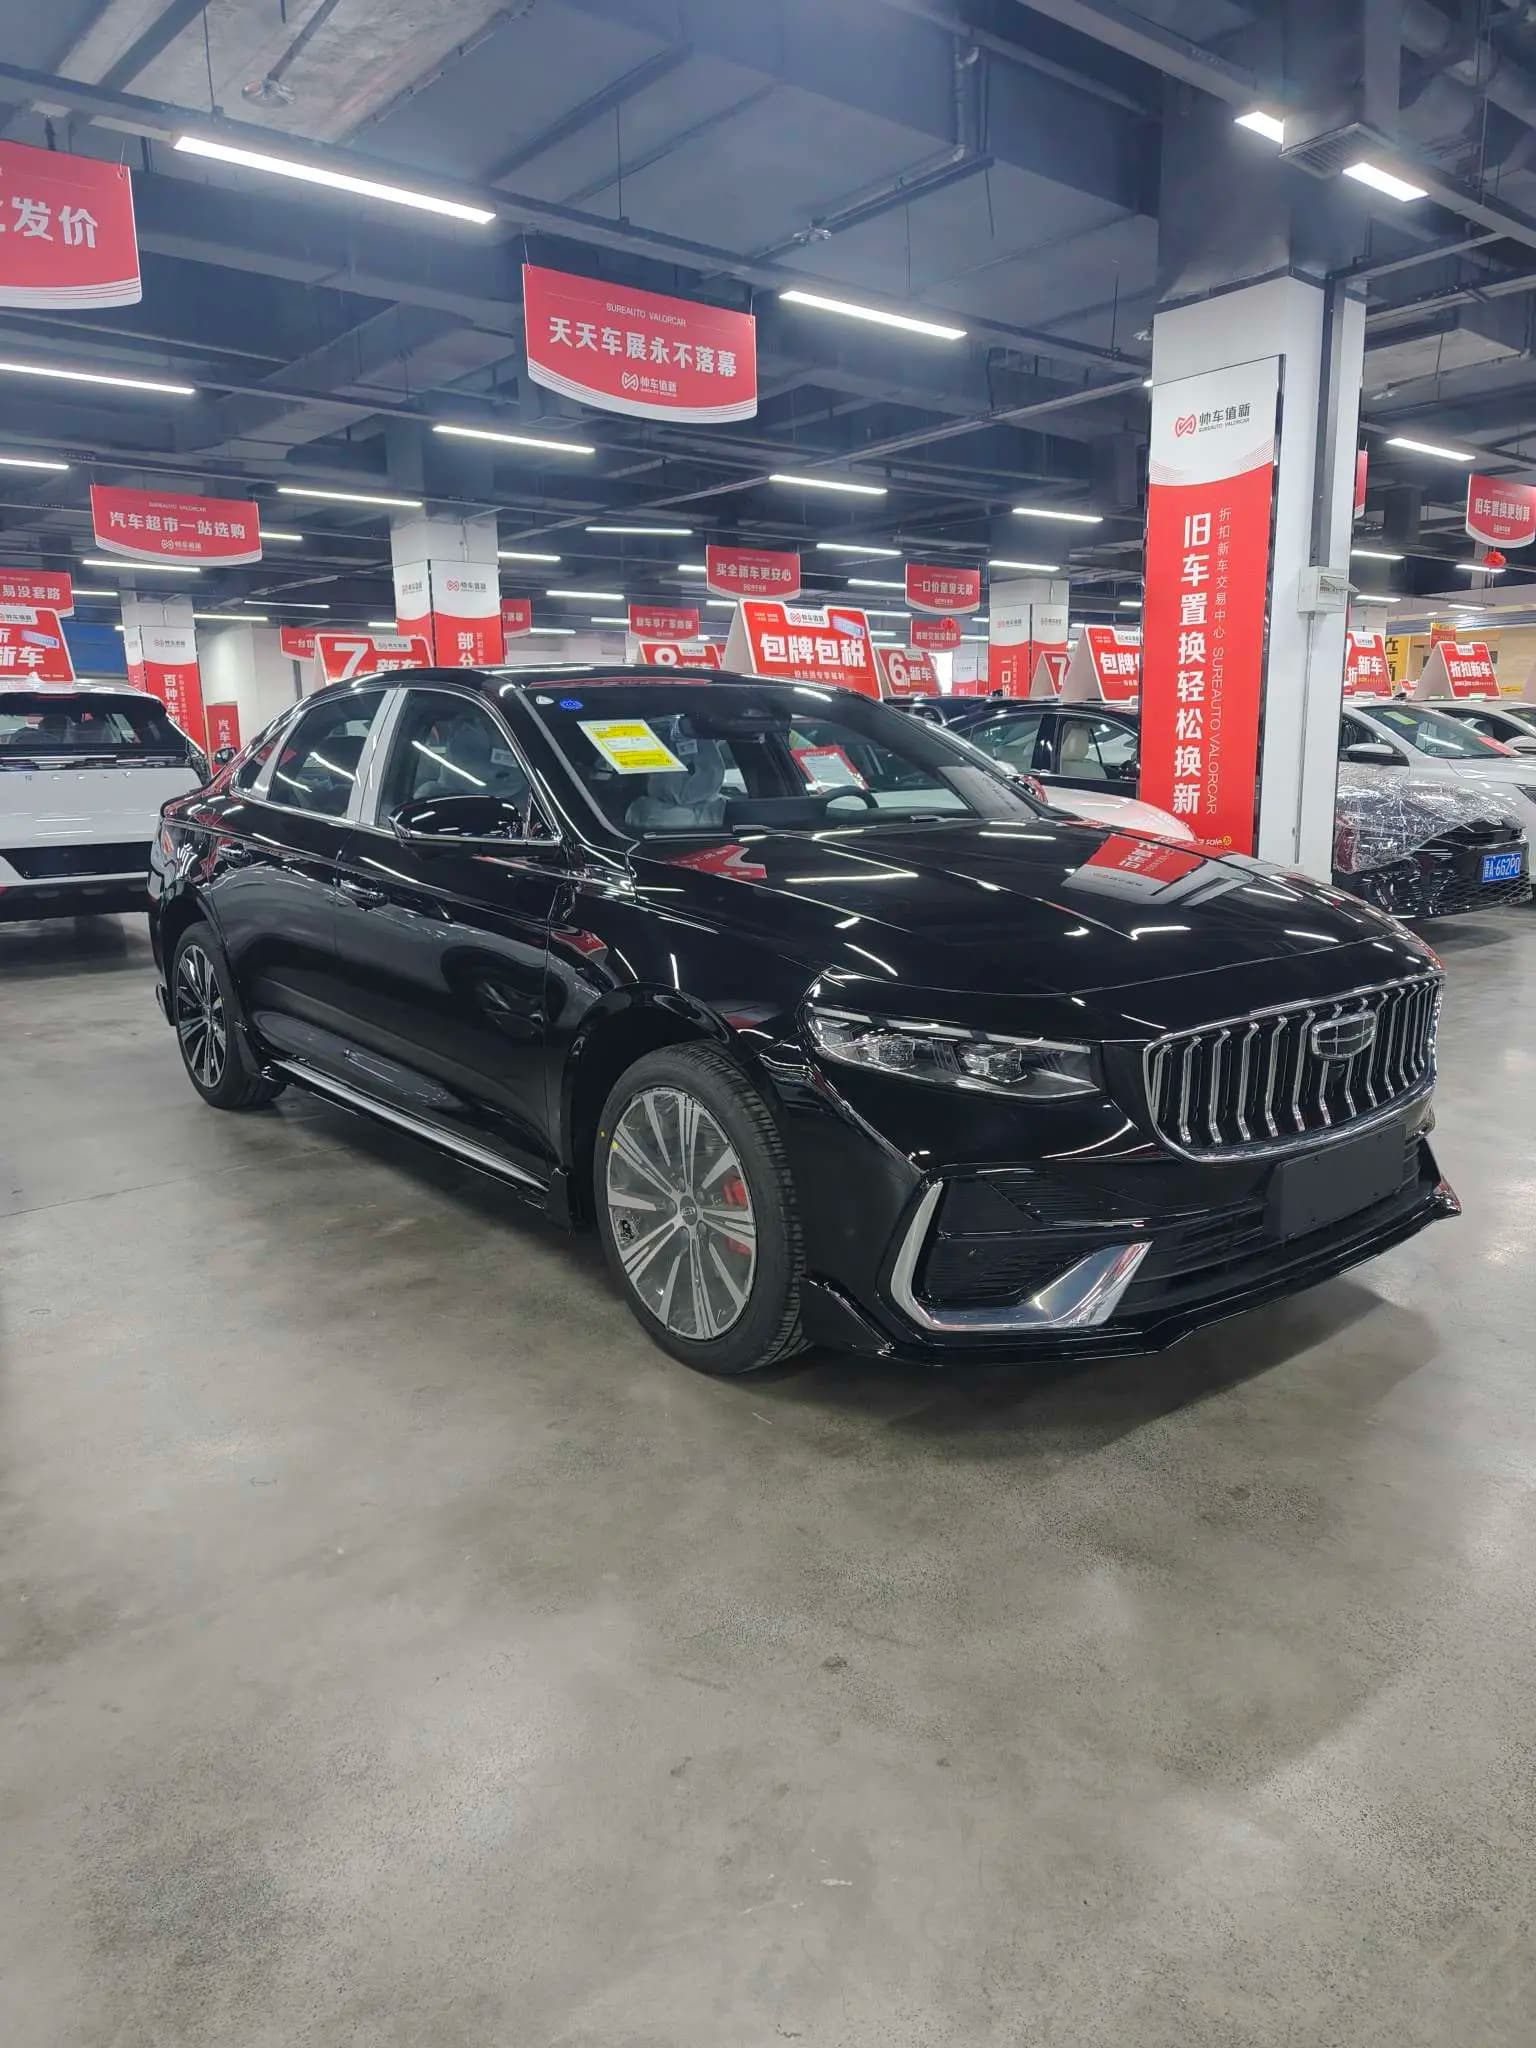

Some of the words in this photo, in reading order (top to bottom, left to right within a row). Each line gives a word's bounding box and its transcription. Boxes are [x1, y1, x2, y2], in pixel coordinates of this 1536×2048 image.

[0, 196, 98, 249] 发价
[548, 316, 738, 378] 天天车展永不落幕
[1199, 402, 1251, 427] 帅车值新
[109, 511, 246, 539] 汽车超市一站选购
[716, 562, 792, 582] 买全新车更安心
[1212, 507, 1232, 640] 折扣新车交易中心
[457, 631, 475, 667] 部分
[759, 632, 867, 668] 包牌包税
[1100, 651, 1139, 676] 包牌
[1172, 512, 1212, 816] 旧车置换轻松换新
[1357, 655, 1384, 676] 新车
[888, 652, 907, 686] 6
[909, 666, 932, 681] 新车
[1052, 656, 1067, 687] 7
[1449, 660, 1492, 678] 折扣新车
[1208, 646, 1225, 732] SUREAUTO
[1206, 733, 1223, 816] VALORCAR
